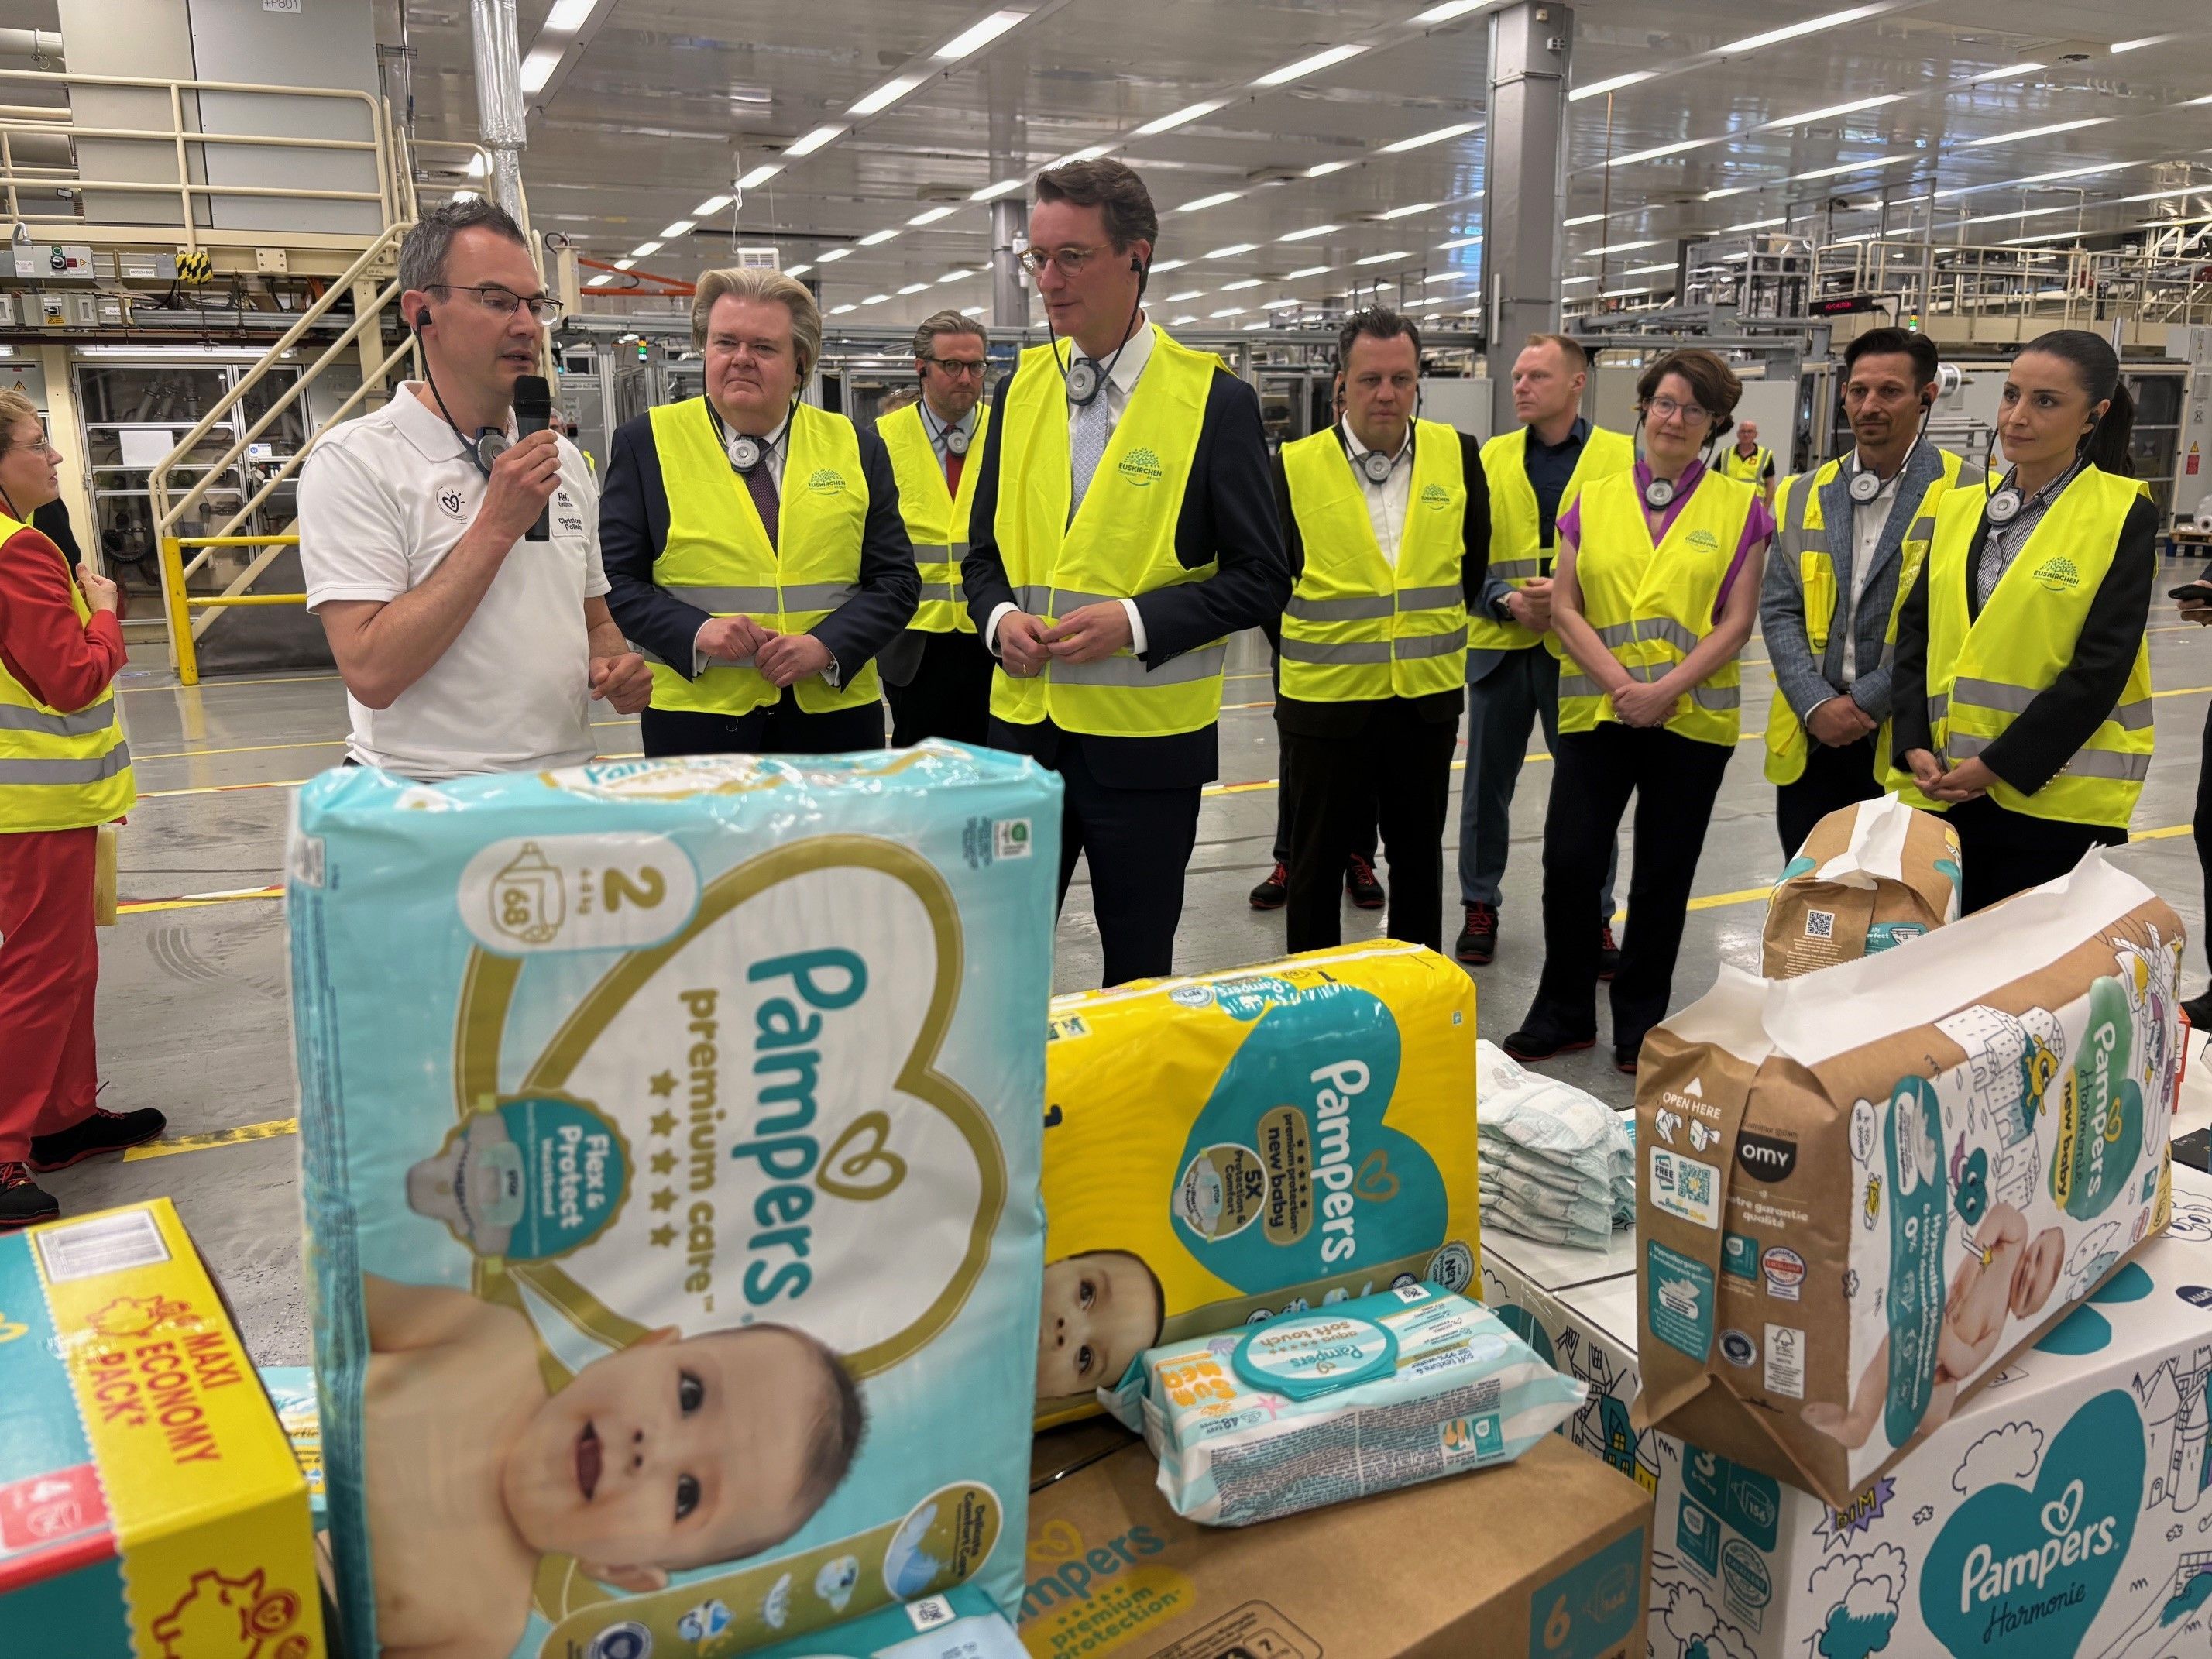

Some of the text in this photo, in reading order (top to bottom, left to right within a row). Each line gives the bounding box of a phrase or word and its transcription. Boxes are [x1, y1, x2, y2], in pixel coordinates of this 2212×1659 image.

[1118, 462, 1163, 477] EUSKIRCHEN
[2033, 569, 2080, 585] EUSKIRCHEN
[503, 888, 531, 927] 68
[603, 865, 667, 912] 2
[680, 987, 724, 1190] premium
[1662, 1091, 1722, 1121] OPEN HERE
[2086, 1020, 2116, 1200] Pampers
[731, 946, 868, 1310] Pampers
[1283, 1113, 1297, 1166] premium
[1741, 1141, 1789, 1168] omy
[2056, 1080, 2073, 1198] new baby
[557, 1125, 583, 1230] Protect
[584, 1134, 610, 1210] Flex &
[1245, 1169, 1262, 1200] 5X
[1268, 1127, 1287, 1228] new baby
[1310, 1058, 1370, 1262] Pampers
[1654, 1163, 1674, 1179] FREE
[1224, 1163, 1236, 1216] Comfort
[1235, 1150, 1245, 1225] Protection &
[1754, 1201, 1809, 1223] garantie
[1742, 1210, 1787, 1230] qualité
[182, 1330, 242, 1389] MAXI
[1259, 1321, 1351, 1348] soft touch
[1290, 1344, 1364, 1368] Pampers
[1321, 1331, 1358, 1343] aqua
[1455, 1352, 1475, 1365] soft
[1424, 1358, 1456, 1372] texture
[133, 1340, 221, 1465] ECONOMY
[1221, 1417, 1239, 1430] 48
[1836, 1487, 1877, 1530] BIM
[1021, 1524, 1166, 1617] mpers
[1960, 1514, 2117, 1615] Pampers
[1050, 1586, 1154, 1649] premium
[1541, 1592, 1571, 1652] 6
[1982, 1582, 2087, 1645] Harmonie
